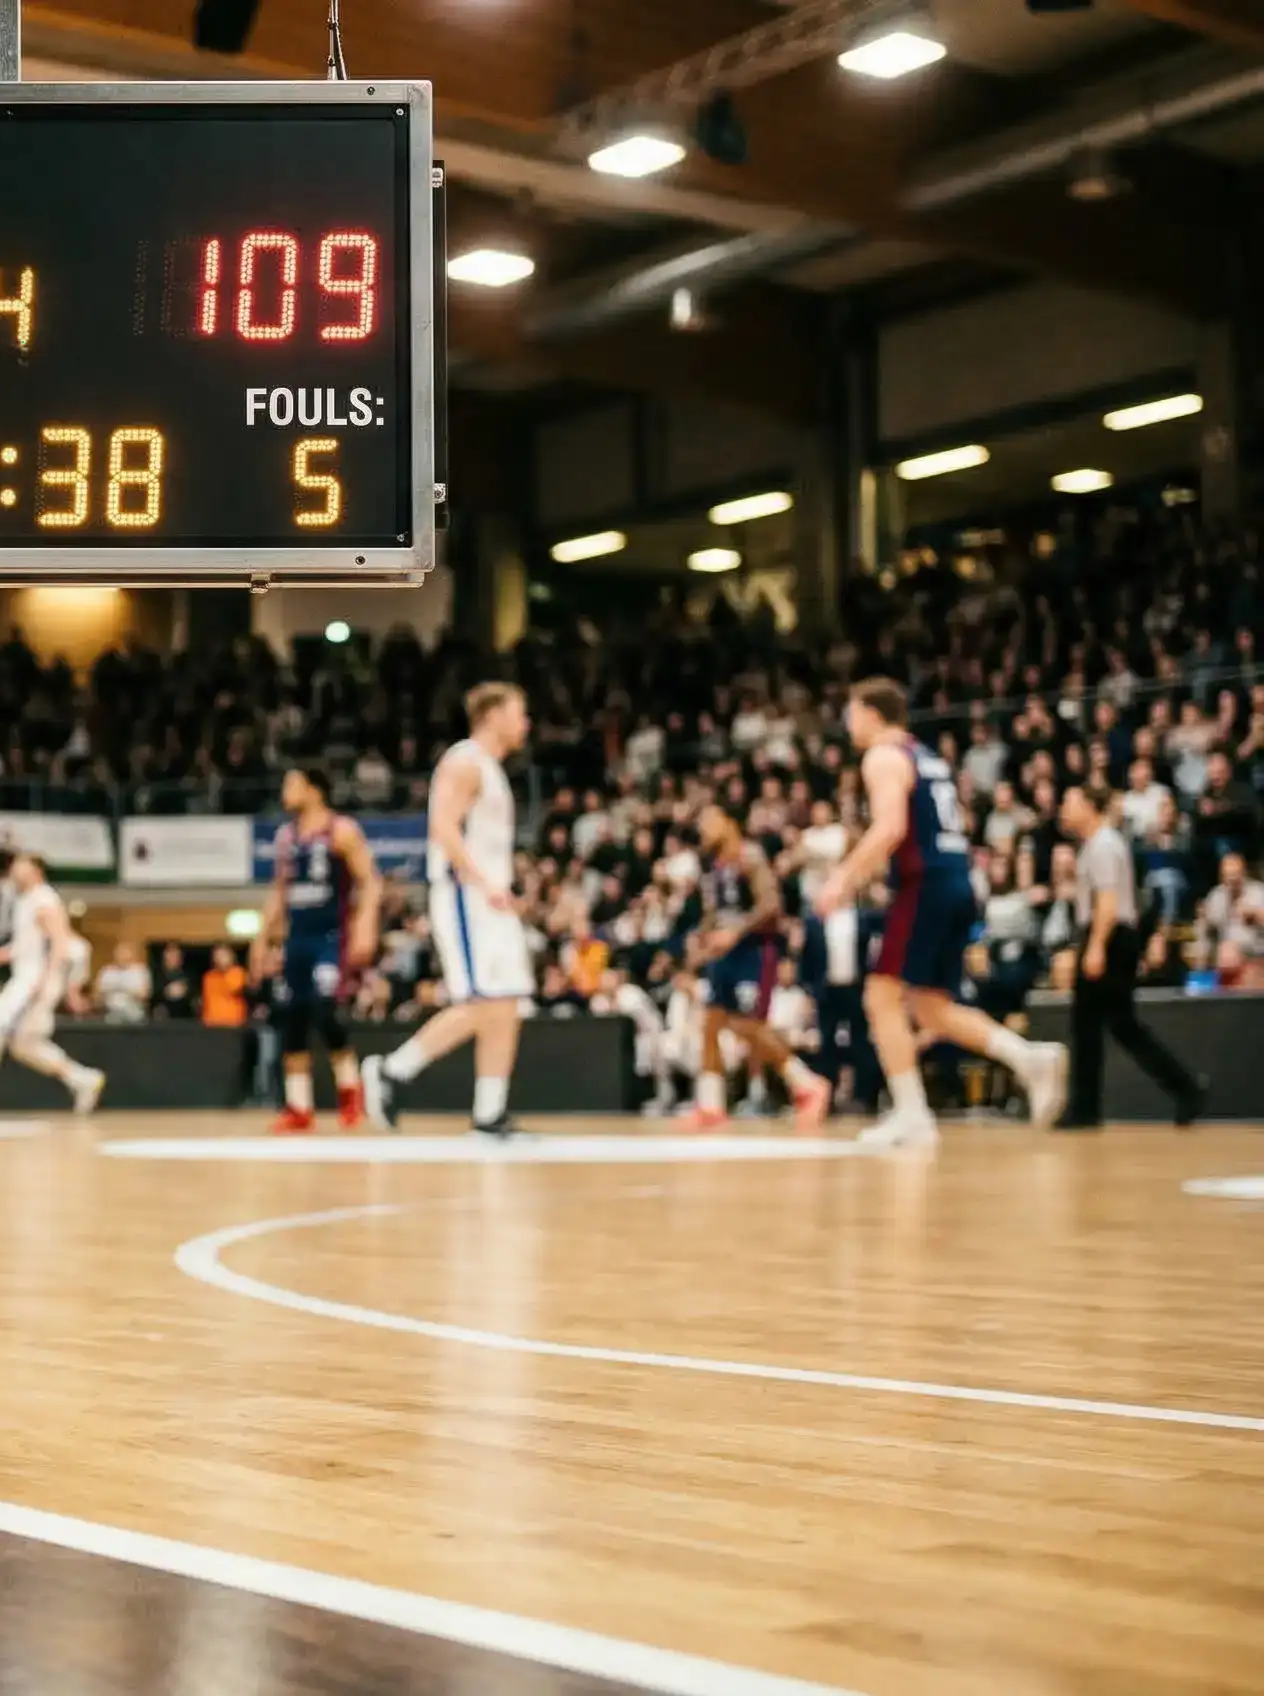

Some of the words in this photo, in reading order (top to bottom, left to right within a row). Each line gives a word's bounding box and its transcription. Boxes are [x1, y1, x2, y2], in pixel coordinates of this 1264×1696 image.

[197, 229, 379, 343] 109
[246, 387, 384, 427] FOULS:
[293, 439, 342, 527] 5
